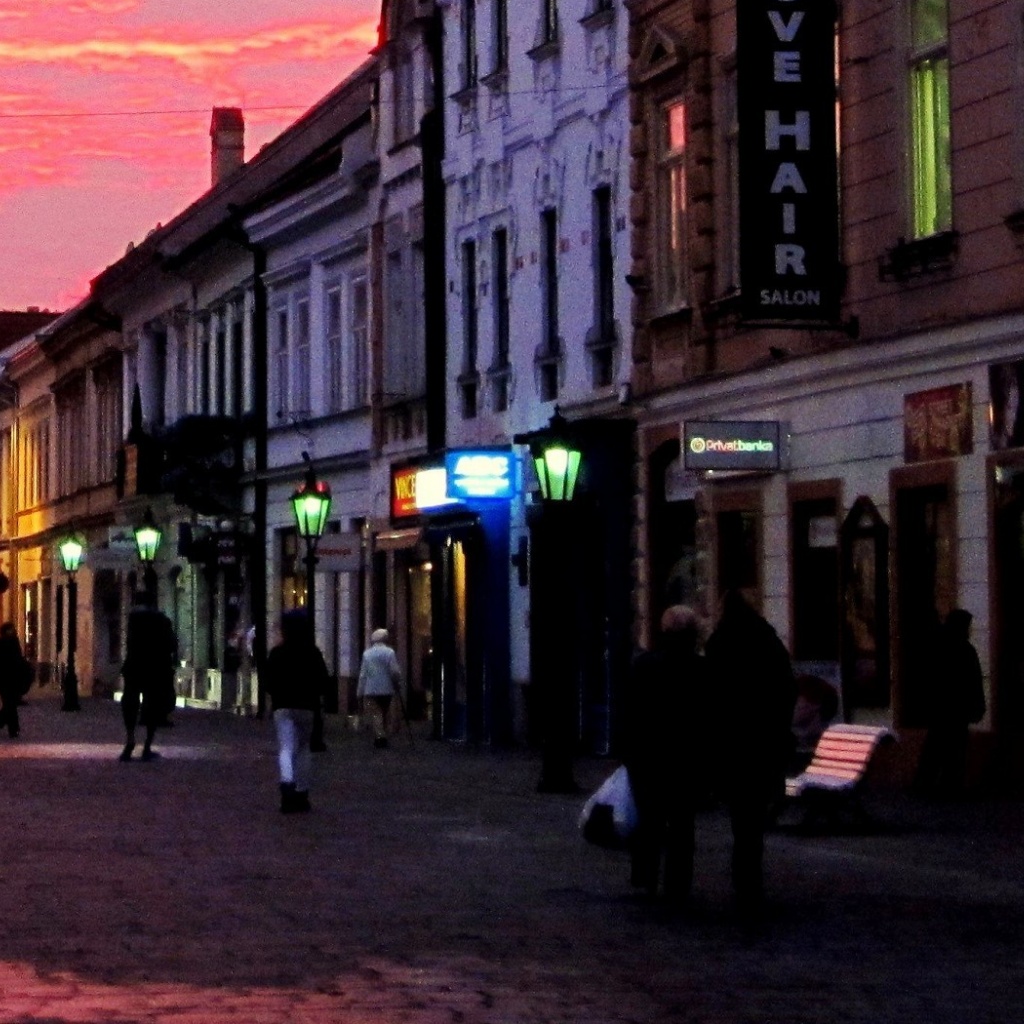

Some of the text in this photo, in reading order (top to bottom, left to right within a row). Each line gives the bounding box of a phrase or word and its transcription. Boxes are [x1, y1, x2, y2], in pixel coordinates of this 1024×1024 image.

[764, 110, 810, 275] HAIR
[760, 289, 821, 306] SALON
[706, 439, 773, 452] Privatbanka
